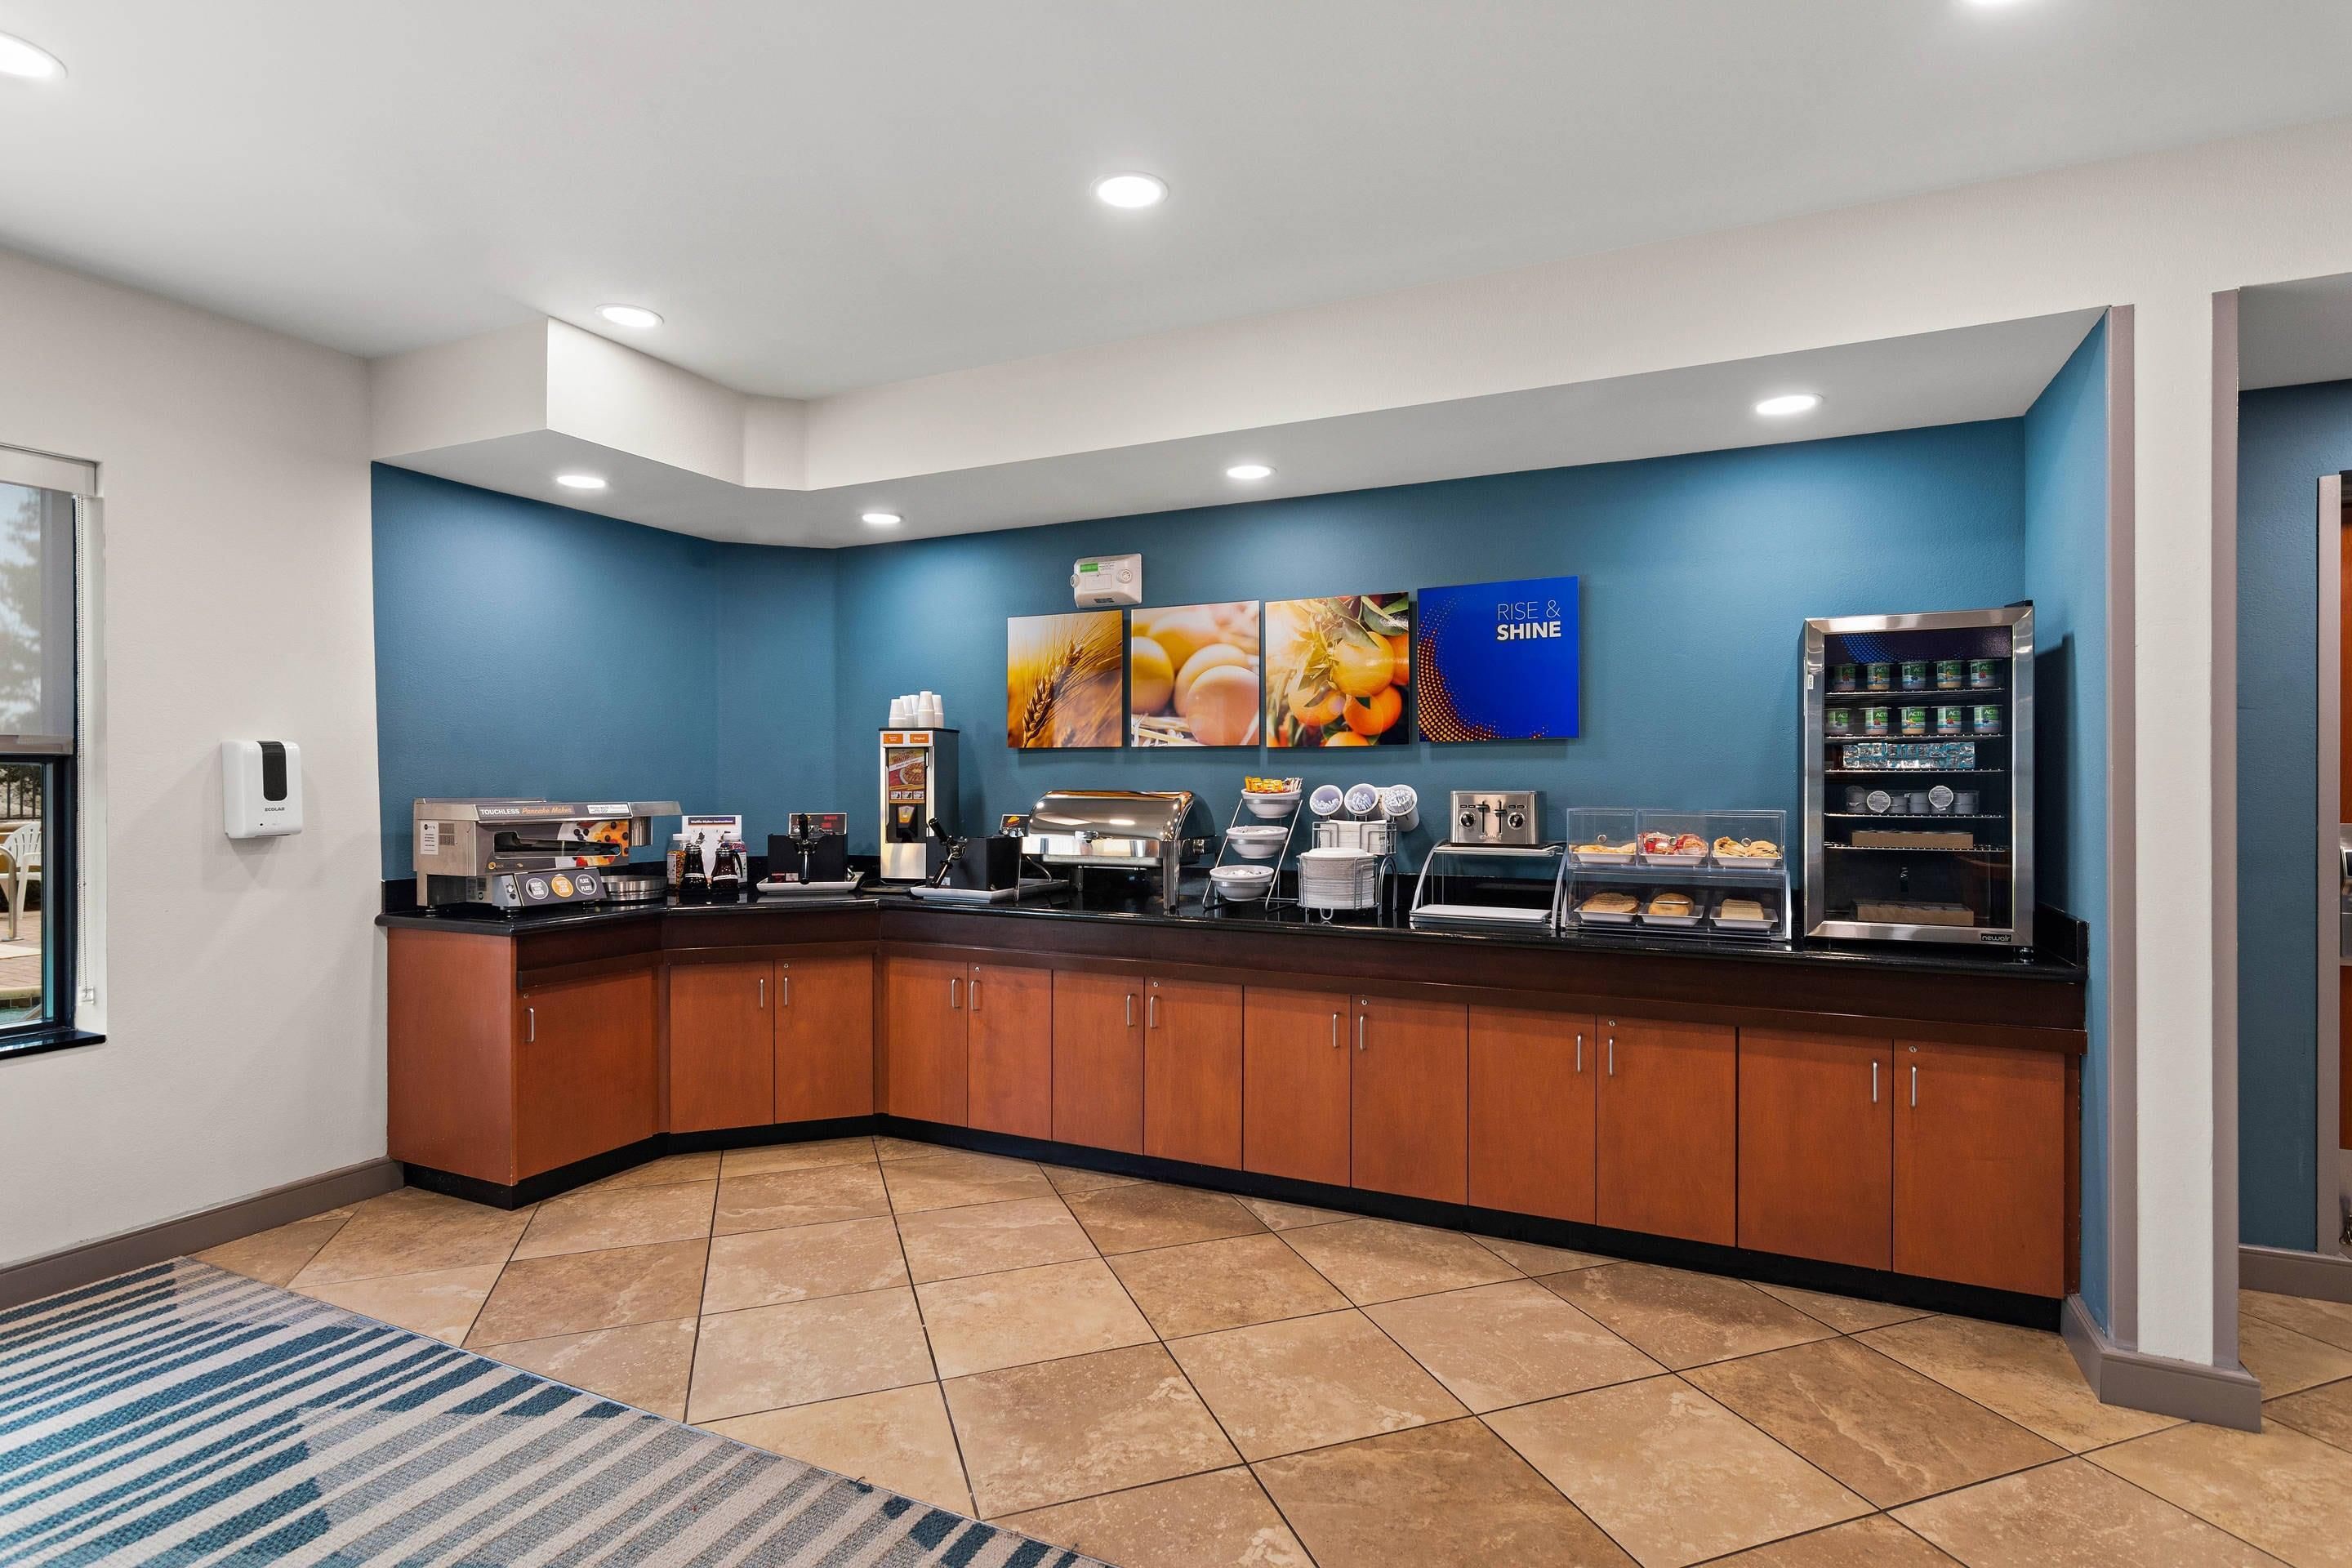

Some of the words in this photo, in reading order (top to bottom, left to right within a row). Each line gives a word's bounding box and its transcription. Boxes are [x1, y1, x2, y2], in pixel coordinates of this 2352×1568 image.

[1498, 602, 1539, 621] RISE
[1545, 599, 1561, 618] &
[1497, 621, 1561, 640] SHINE
[522, 806, 550, 814] Pancake
[551, 806, 572, 814] Maker
